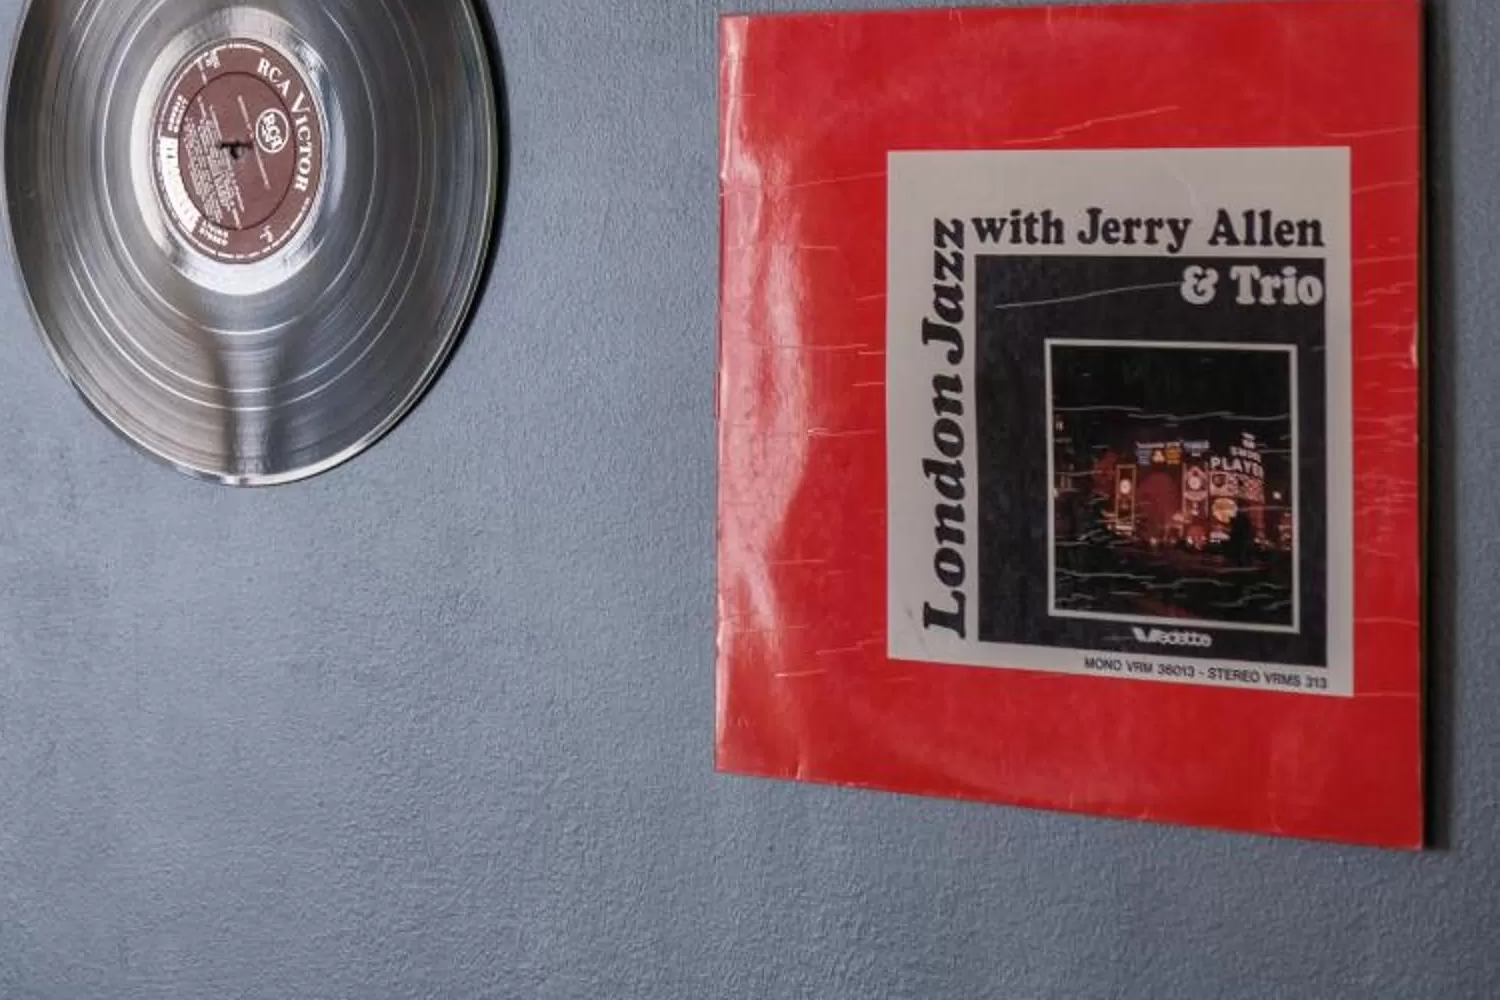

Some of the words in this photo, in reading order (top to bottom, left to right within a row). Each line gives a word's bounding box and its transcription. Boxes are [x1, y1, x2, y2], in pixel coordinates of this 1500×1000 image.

[257, 57, 292, 98] RCA
[972, 208, 1065, 246] with
[1078, 207, 1192, 254] Jerry
[1207, 209, 1325, 247] Allen
[921, 217, 966, 365] Jazz
[1180, 265, 1220, 306] &
[1231, 265, 1325, 306] Trio
[921, 373, 967, 640] London
[1084, 657, 1122, 671] MONO
[1126, 660, 1153, 673] VRM
[1207, 667, 1260, 683] STEREO
[1264, 673, 1301, 687] VRMS
[1305, 676, 1328, 690] 313
